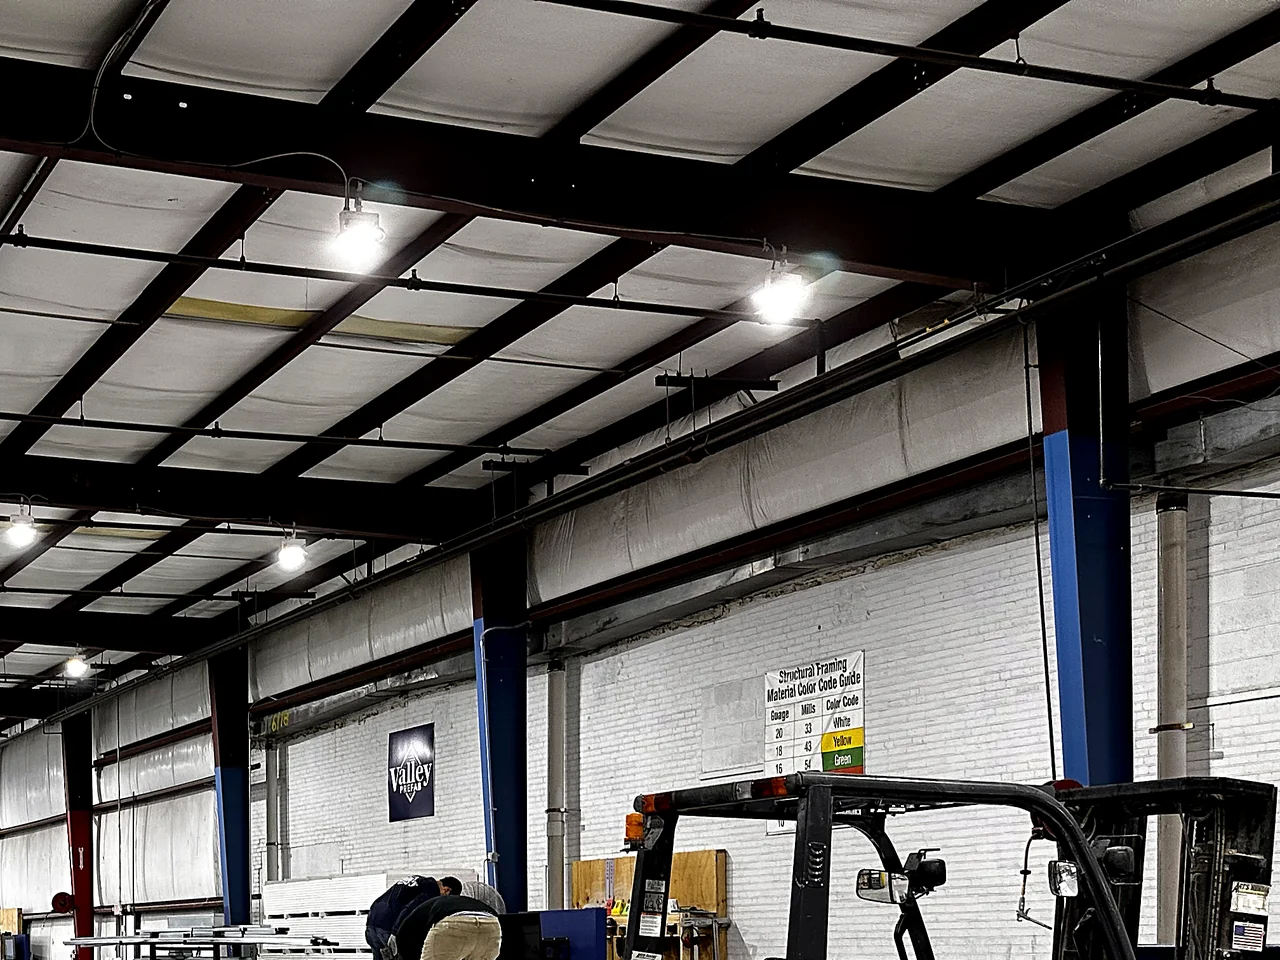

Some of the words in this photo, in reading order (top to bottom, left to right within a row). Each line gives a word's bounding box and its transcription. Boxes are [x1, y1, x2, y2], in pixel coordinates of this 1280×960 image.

[778, 664, 815, 684] Structural
[816, 658, 848, 676] Framing
[767, 683, 797, 703] Material
[797, 681, 816, 696] Color
[818, 676, 837, 693] Code
[839, 671, 861, 690] Guide
[770, 709, 790, 722] Guage
[801, 703, 816, 716] Mills
[826, 698, 841, 711] Color
[842, 695, 859, 708] Code
[775, 727, 784, 739] 20
[804, 723, 812, 734] 33
[833, 716, 851, 729] White
[775, 746, 783, 757] 18
[803, 741, 812, 752] 43
[832, 735, 852, 748] Yellow
[775, 763, 783, 774] 16
[804, 759, 812, 771] 54
[834, 753, 852, 766] Green
[389, 760, 433, 793] Valley
[400, 782, 422, 794] PREFAB
